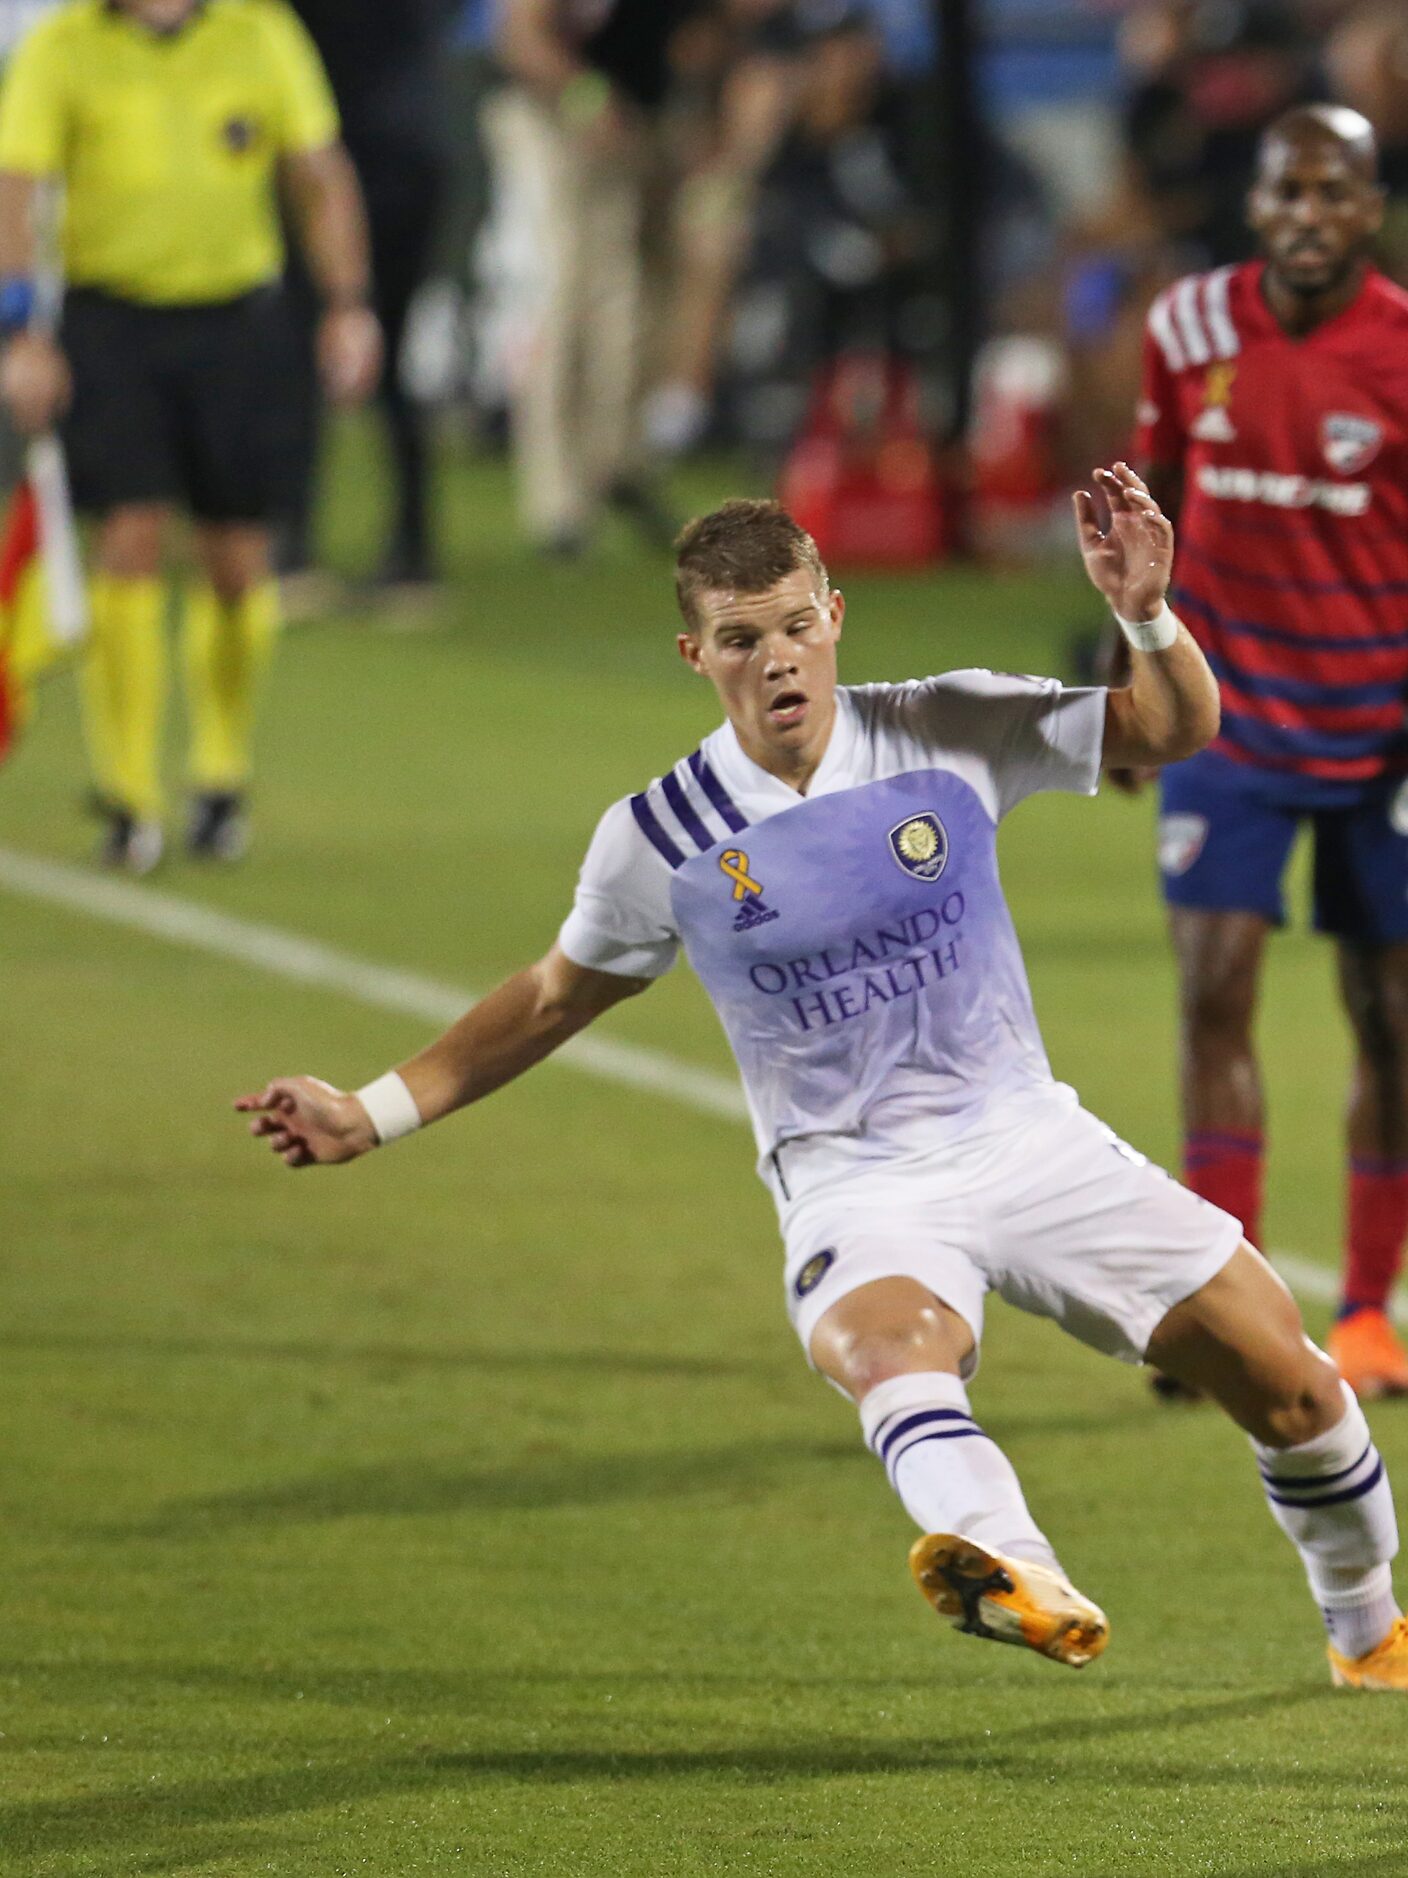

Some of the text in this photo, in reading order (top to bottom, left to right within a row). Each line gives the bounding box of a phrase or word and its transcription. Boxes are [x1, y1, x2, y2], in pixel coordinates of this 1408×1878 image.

[733, 909, 780, 932] adidas
[750, 891, 965, 995] ORLANDO
[791, 941, 959, 1031] HEALTH
